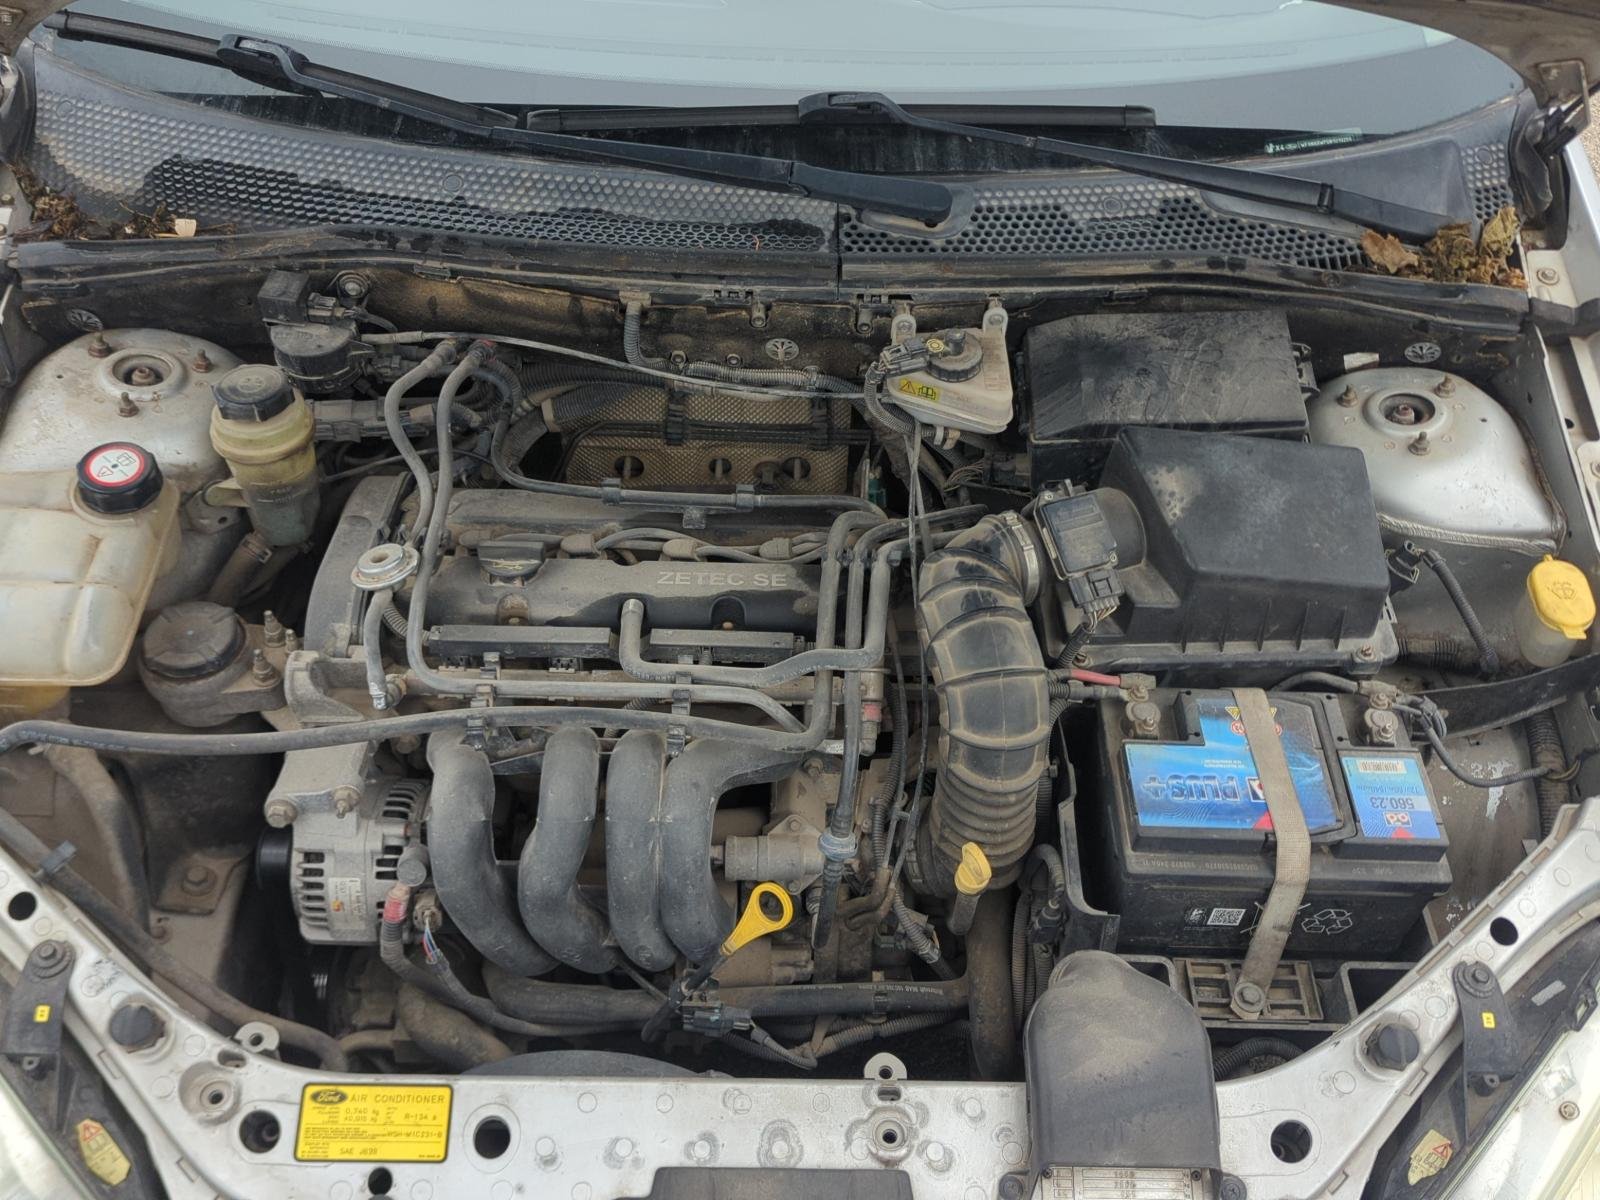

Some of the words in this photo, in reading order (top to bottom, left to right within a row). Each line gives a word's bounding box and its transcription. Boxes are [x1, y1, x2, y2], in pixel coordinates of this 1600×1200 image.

[657, 571, 745, 586] ZETEC
[753, 572, 788, 587] SE
[315, 1090, 344, 1104] Ford
[350, 1094, 368, 1103] AIR
[374, 1094, 445, 1104] CONDITIONER
